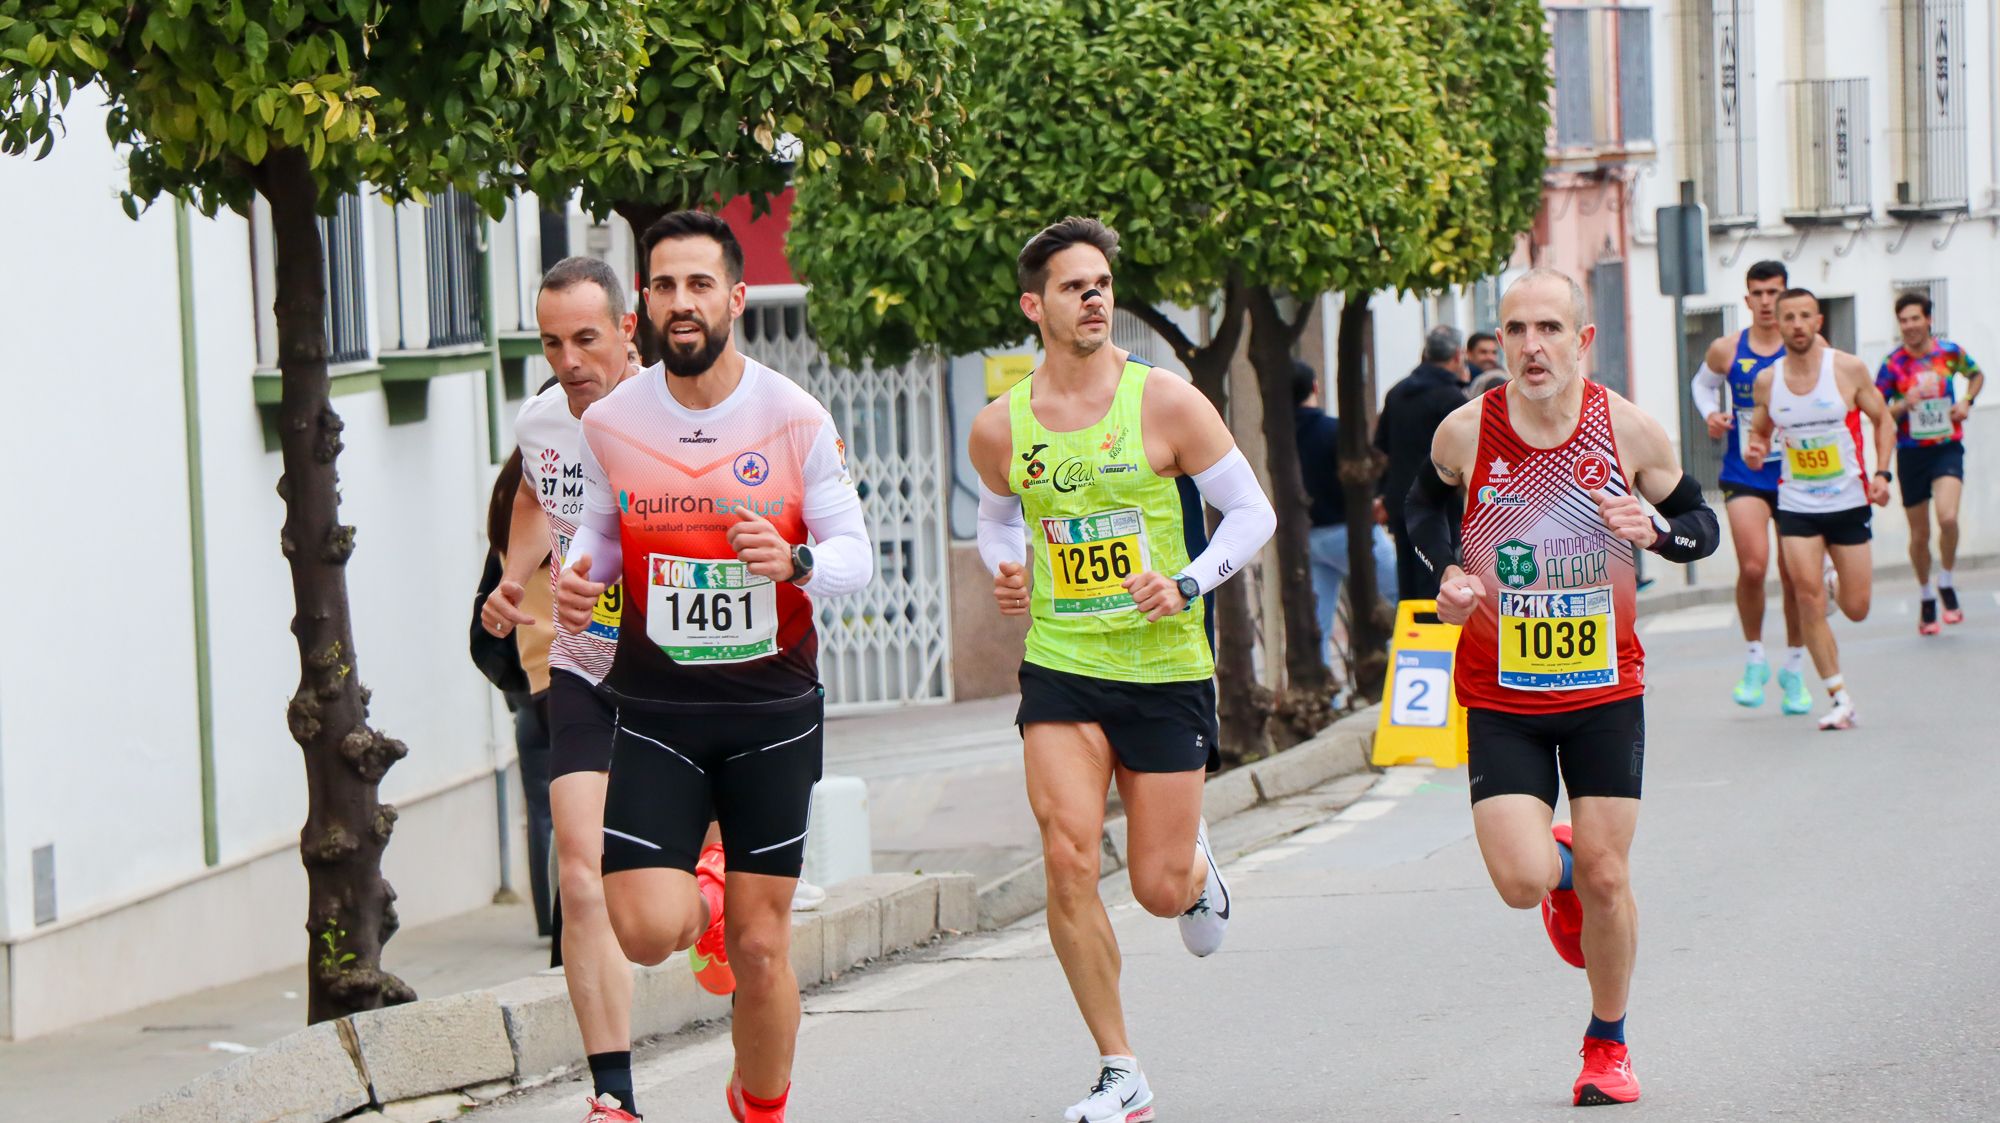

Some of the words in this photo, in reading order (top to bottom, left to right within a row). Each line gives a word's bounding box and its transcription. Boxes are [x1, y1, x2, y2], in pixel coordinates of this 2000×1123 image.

[1796, 450, 1829, 469] 659
[541, 477, 558, 496] 37
[1488, 476, 1512, 484] luanvi
[635, 493, 784, 521] quirónsalud
[656, 523, 684, 533] salud
[686, 524, 728, 535] persona
[1047, 520, 1075, 544] 10K
[1674, 535, 1697, 549] KIPRUN
[1543, 530, 1606, 558] FUNDACIÓN
[660, 561, 697, 589] 10K
[1057, 541, 1132, 585] 1256
[1545, 550, 1608, 589] ALBOR
[665, 591, 753, 632] 1461
[1513, 594, 1549, 618] 21K
[1514, 620, 1597, 659] 1038
[1397, 654, 1420, 667] km
[1406, 679, 1430, 711] 2
